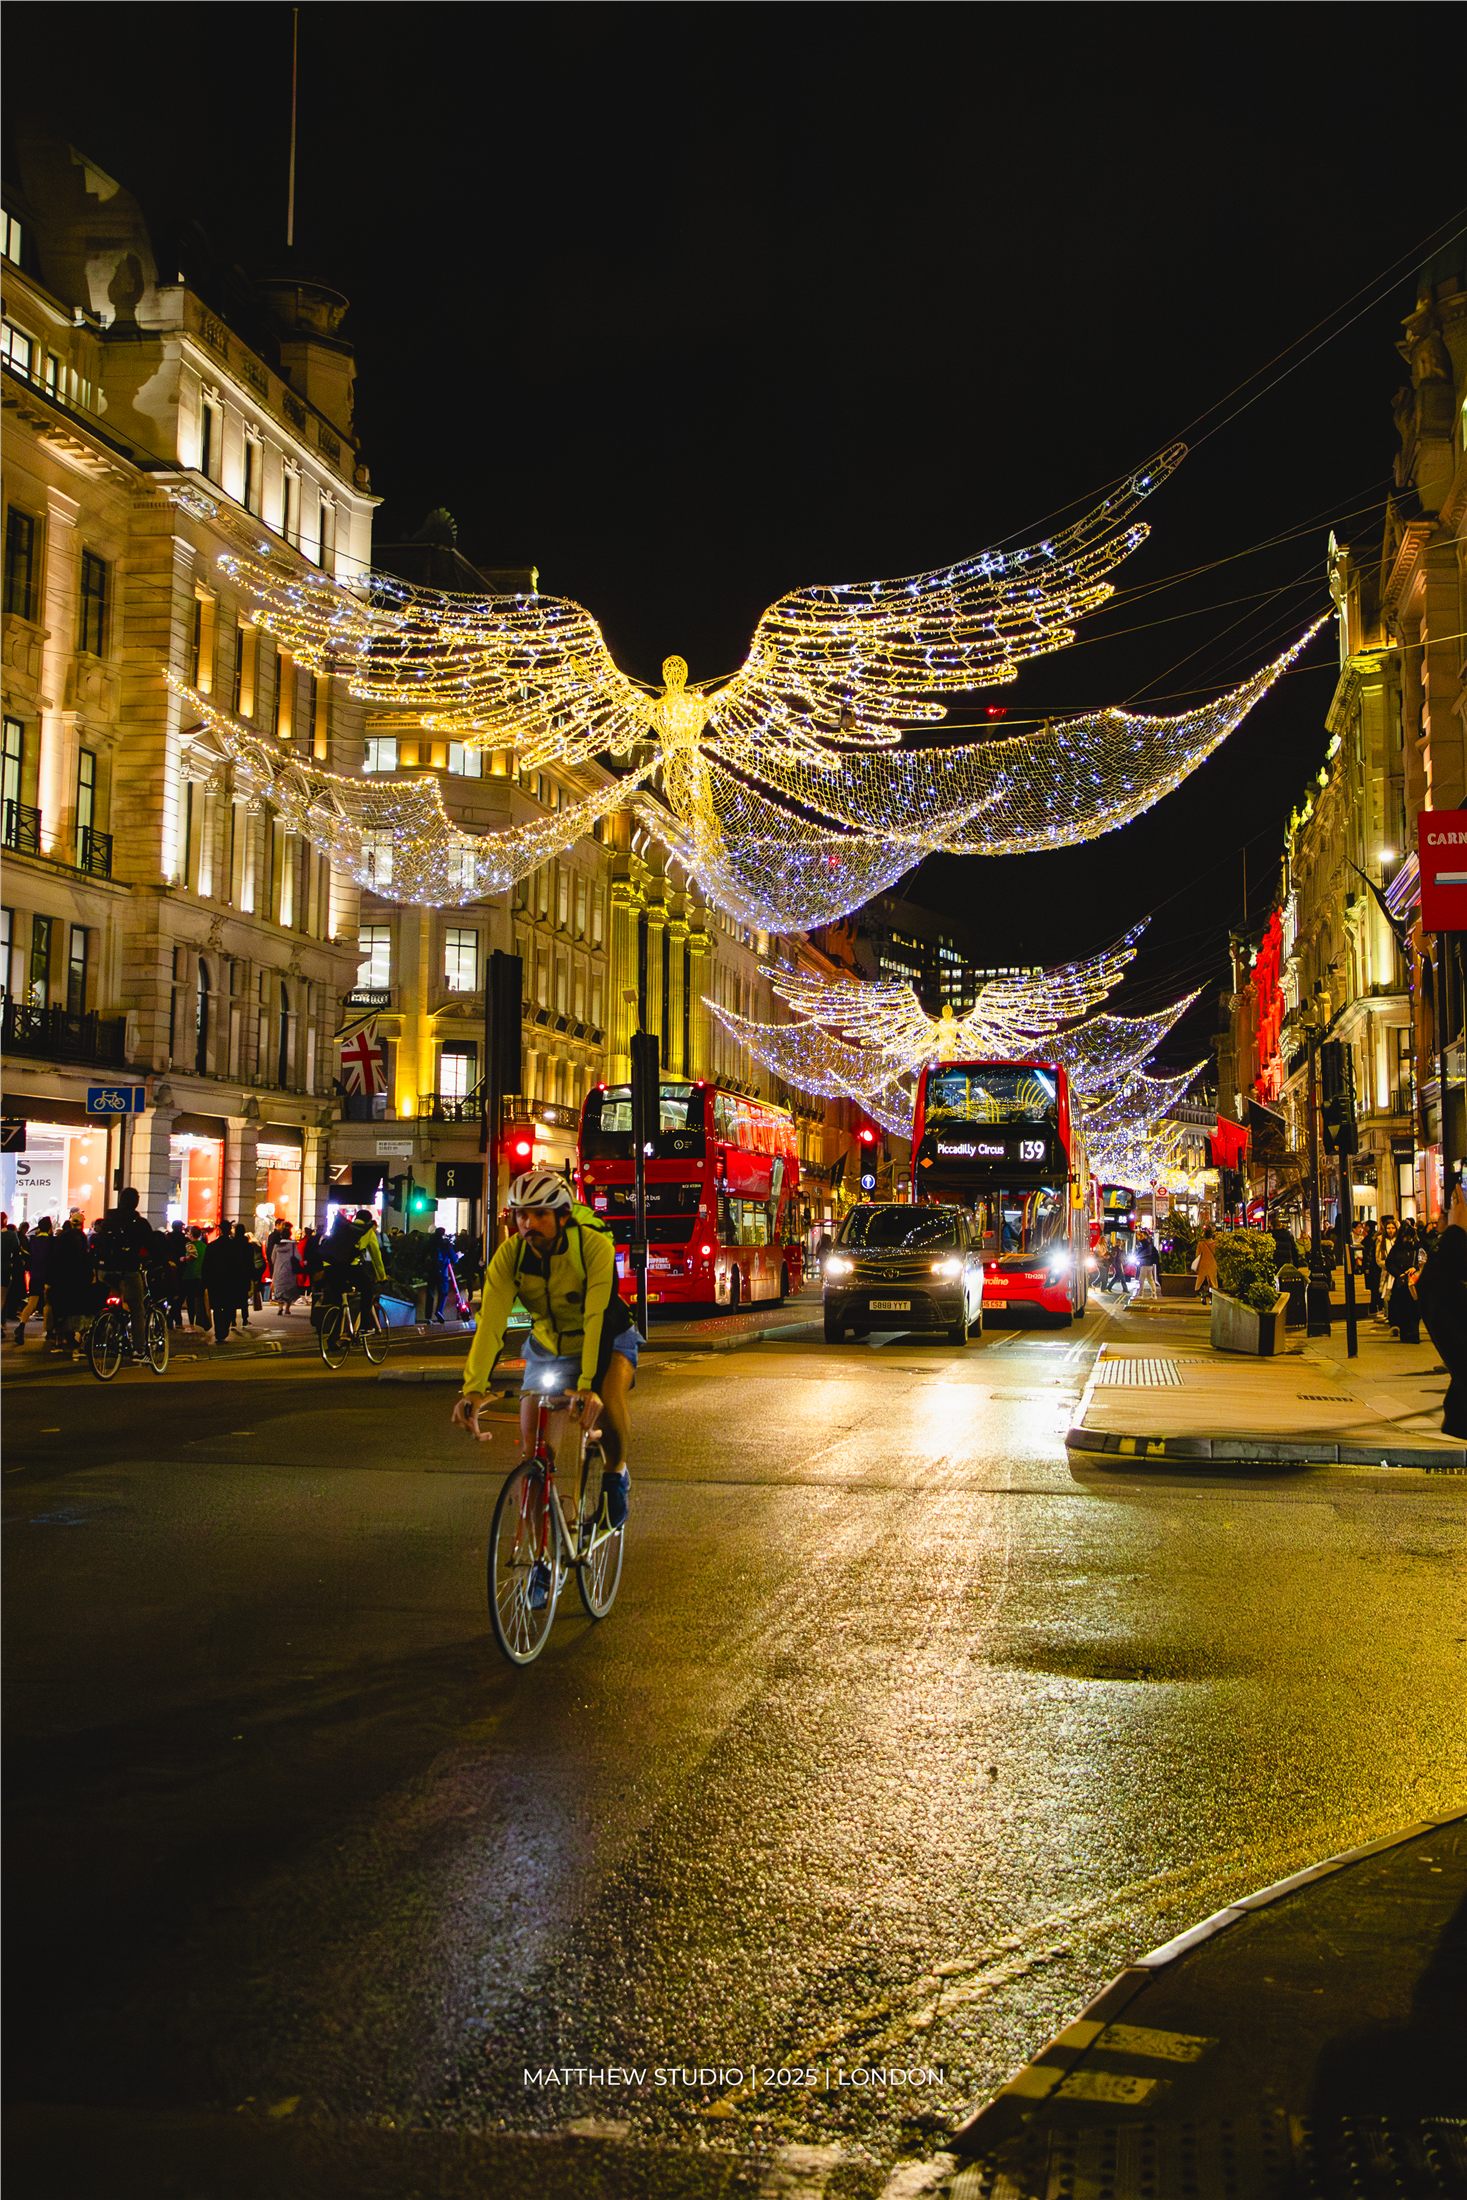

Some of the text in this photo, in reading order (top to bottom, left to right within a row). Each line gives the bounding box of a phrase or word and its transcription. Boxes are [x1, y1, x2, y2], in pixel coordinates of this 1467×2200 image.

[937, 1143, 1004, 1156] Piccadilly Circus
[1020, 1140, 1045, 1159] 139
